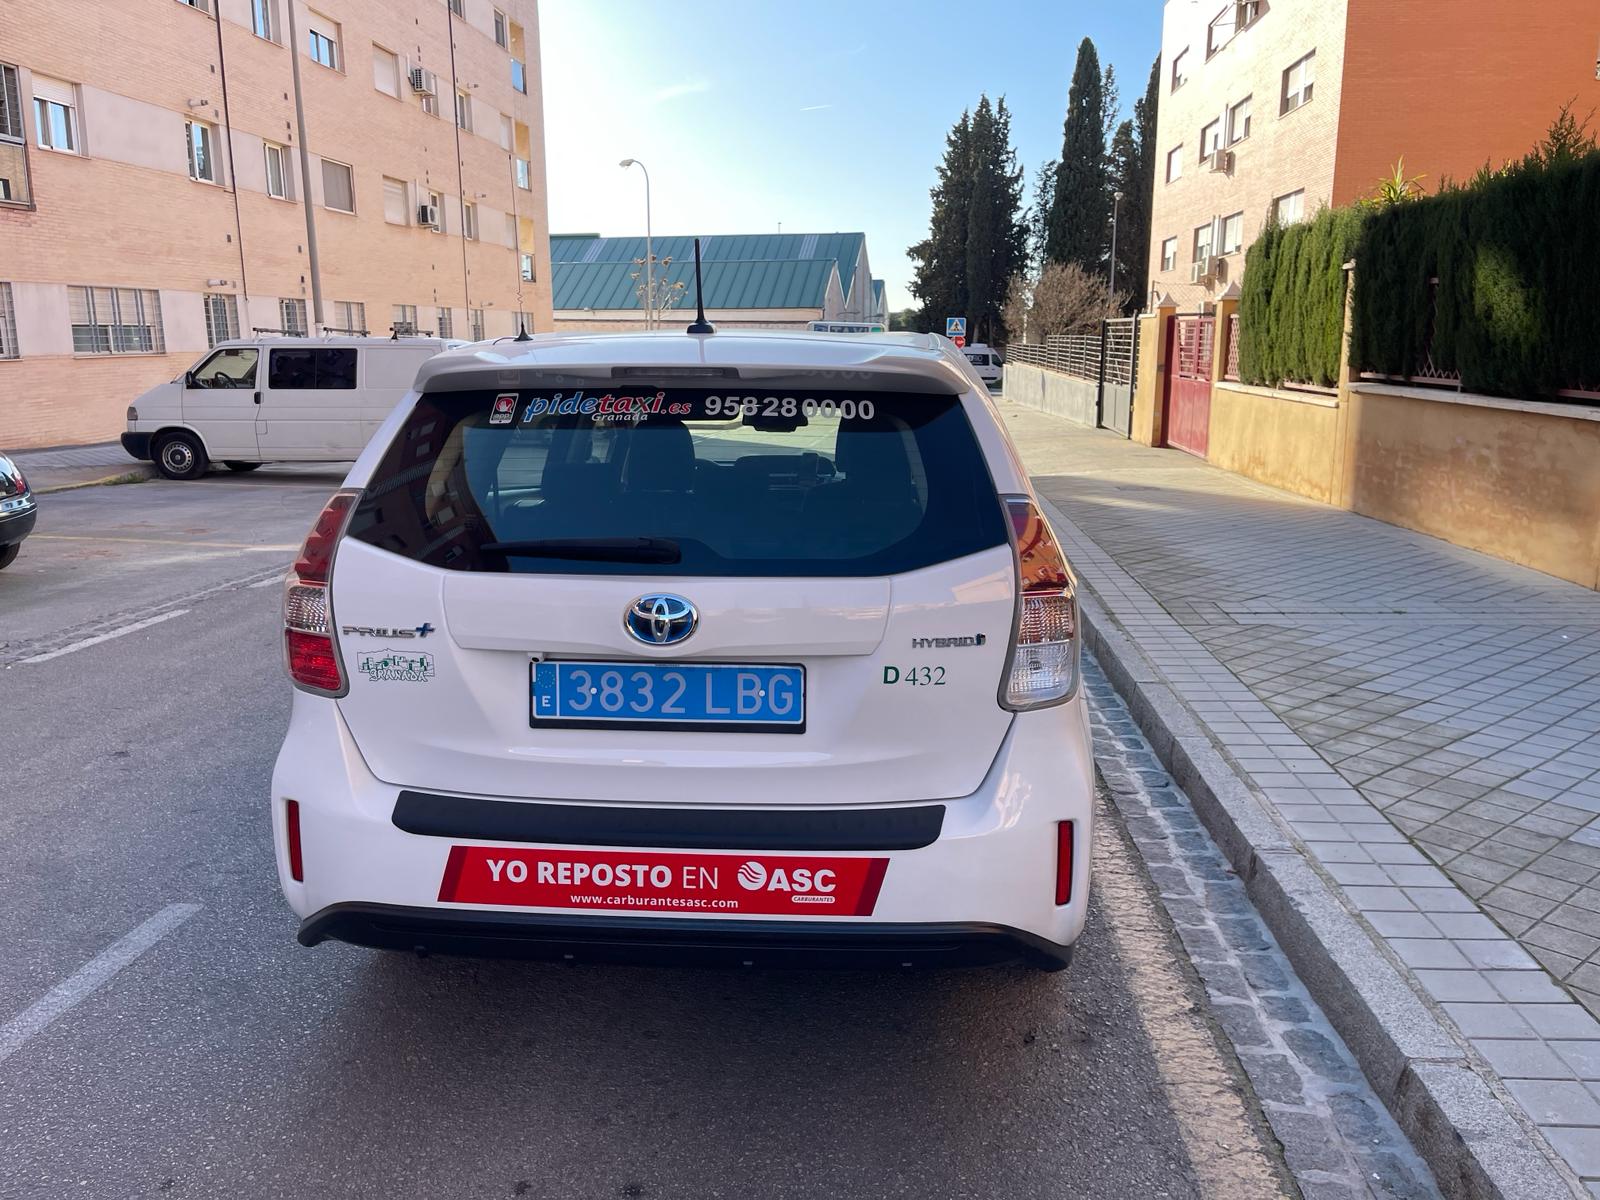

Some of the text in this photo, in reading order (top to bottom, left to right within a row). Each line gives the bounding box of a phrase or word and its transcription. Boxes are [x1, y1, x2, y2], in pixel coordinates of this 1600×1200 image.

[523, 391, 692, 423] pidetaxi.es
[591, 412, 649, 421] Granada
[912, 636, 976, 649] HYBRID
[883, 666, 946, 686] D 432
[541, 670, 793, 715] E 3832 LBG
[486, 859, 719, 890] YO REPOSTO EN
[767, 868, 837, 893] ASC
[570, 894, 739, 909] www.carburantesasc.com
